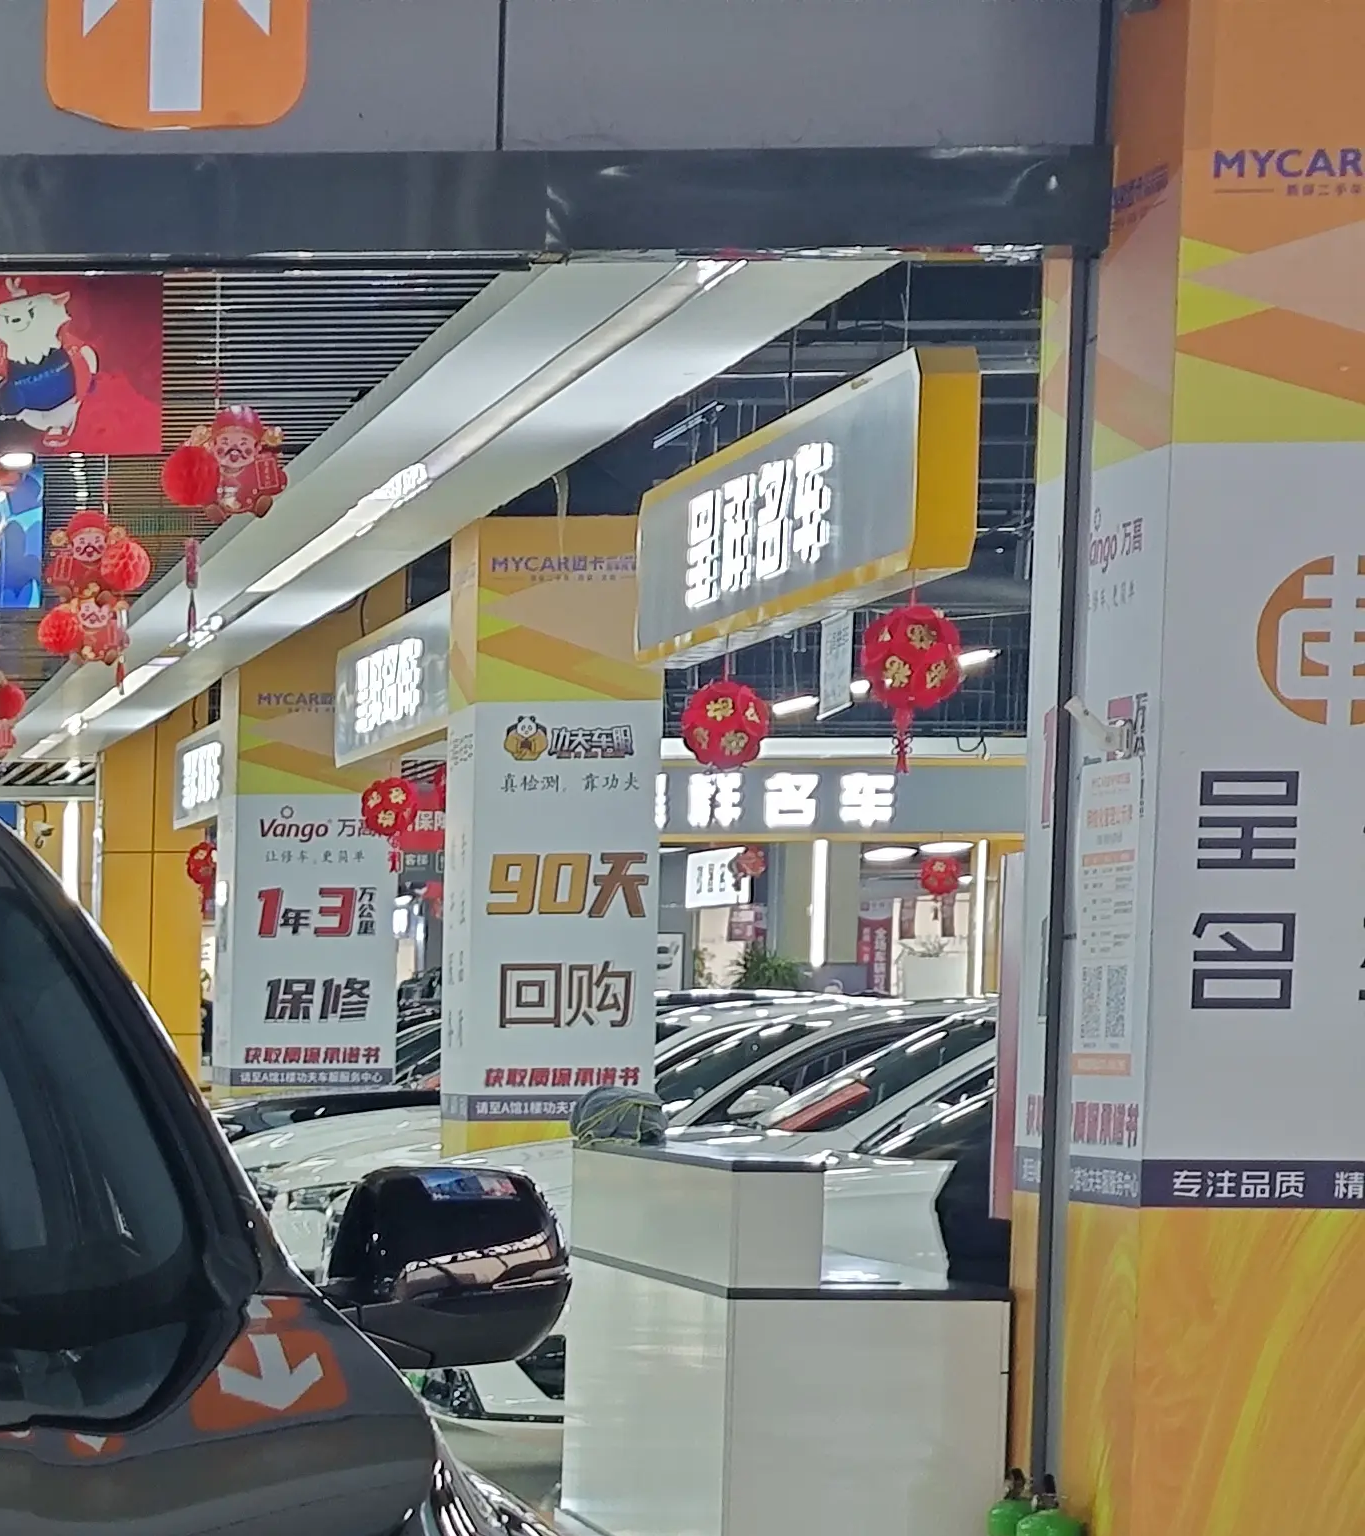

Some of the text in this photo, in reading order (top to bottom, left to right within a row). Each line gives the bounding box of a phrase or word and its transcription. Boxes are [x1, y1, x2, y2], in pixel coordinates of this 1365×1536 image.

[1213, 148, 1363, 178] MYCAR
[1088, 532, 1117, 574] ango
[654, 772, 898, 830] 祥名车
[259, 817, 330, 843] Vango
[486, 852, 649, 918] 90天
[264, 976, 371, 1025] 保修
[500, 961, 639, 1029] 回购
[1172, 1169, 1305, 1199] 专注品质
